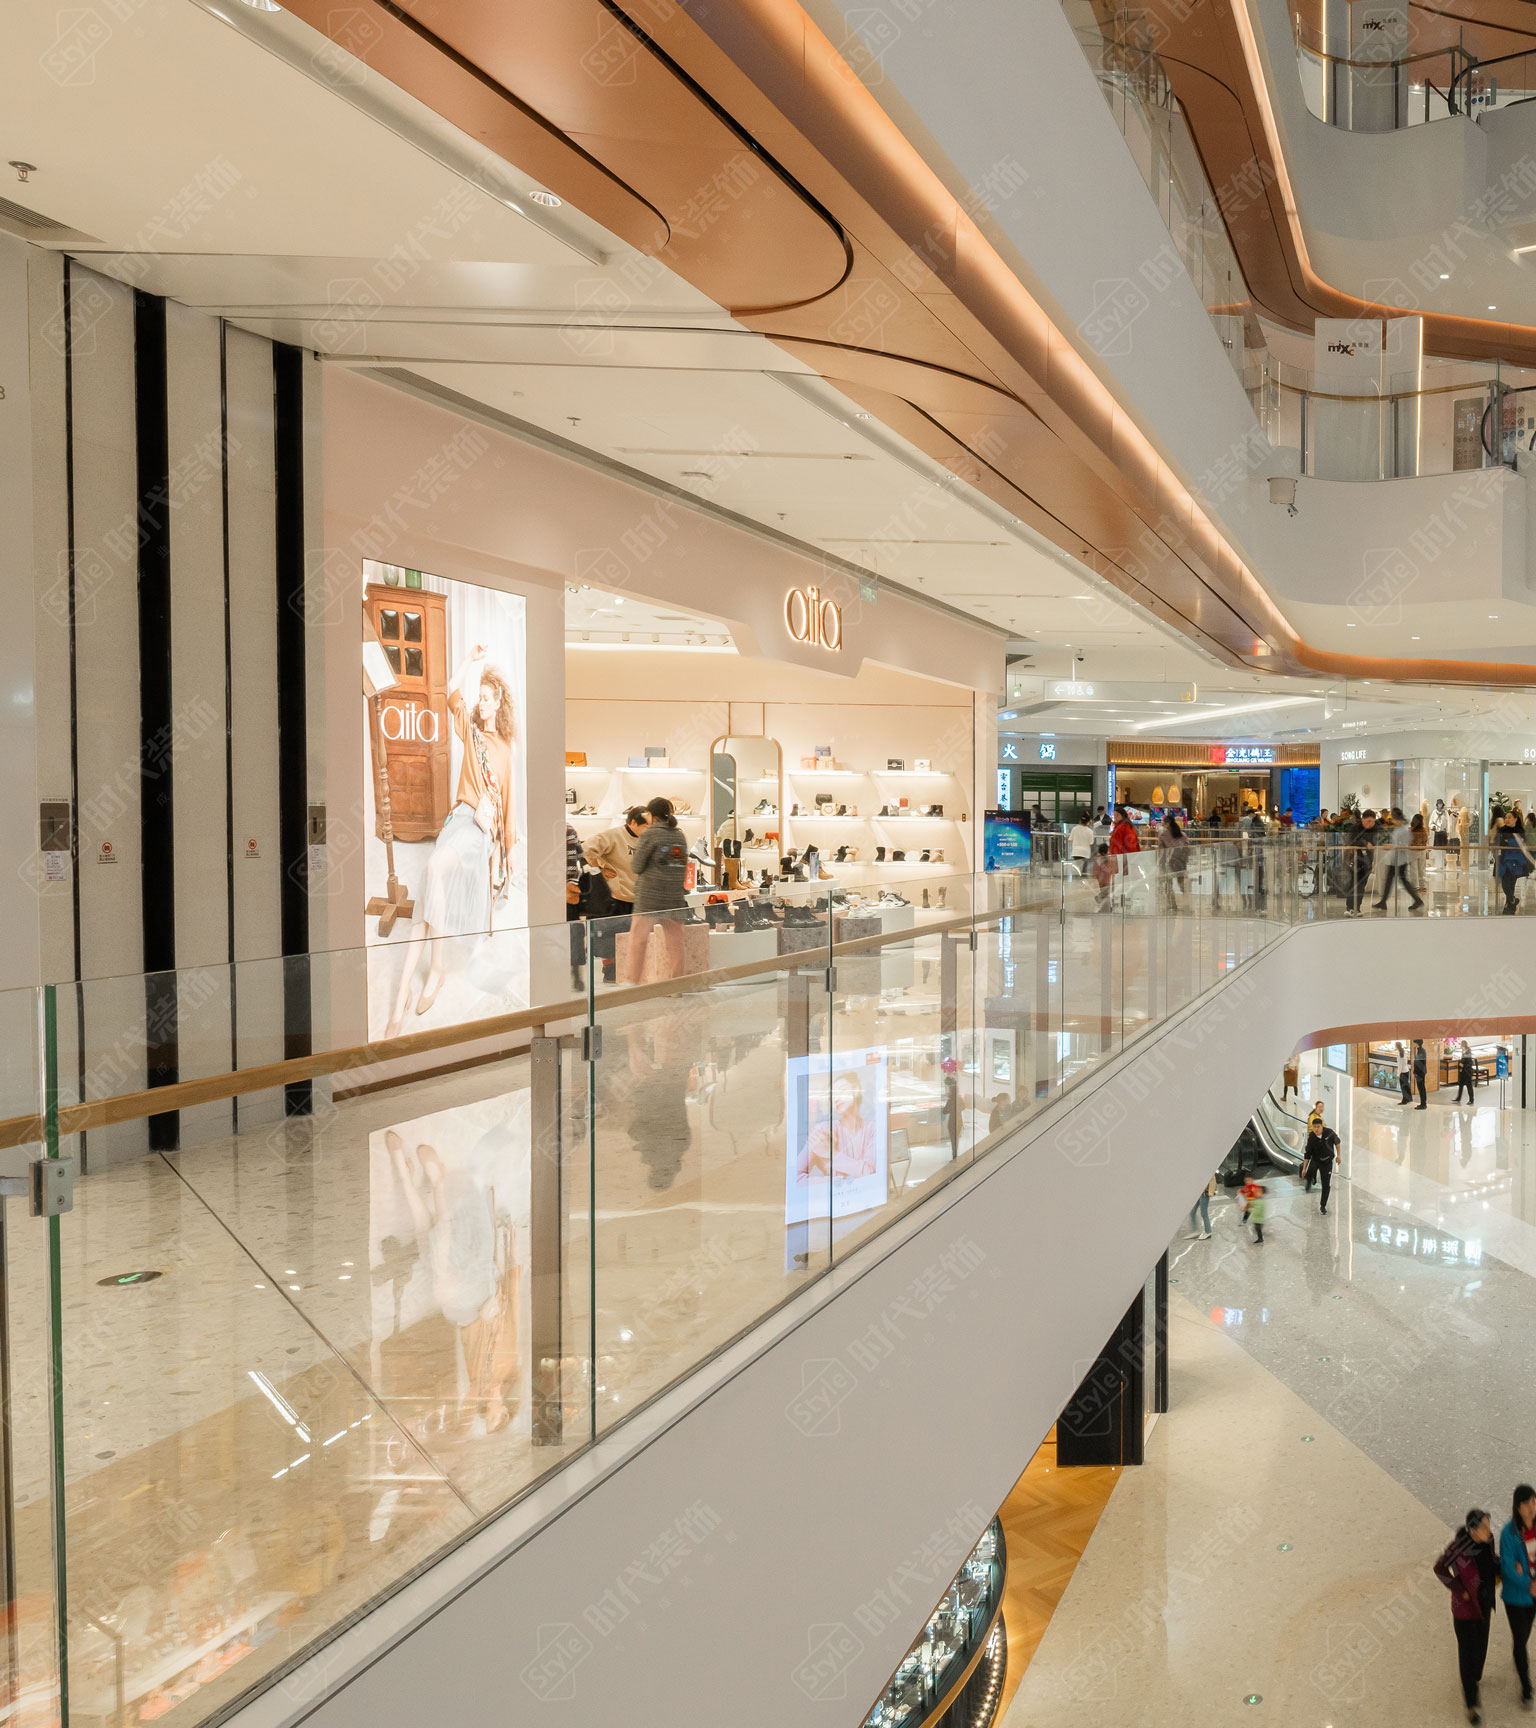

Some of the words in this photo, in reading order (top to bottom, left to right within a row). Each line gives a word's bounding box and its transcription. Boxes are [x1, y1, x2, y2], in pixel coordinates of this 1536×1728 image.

[380, 704, 440, 744] aita
[1341, 750, 1355, 761] SONG
[1355, 749, 1367, 760] LIFE
